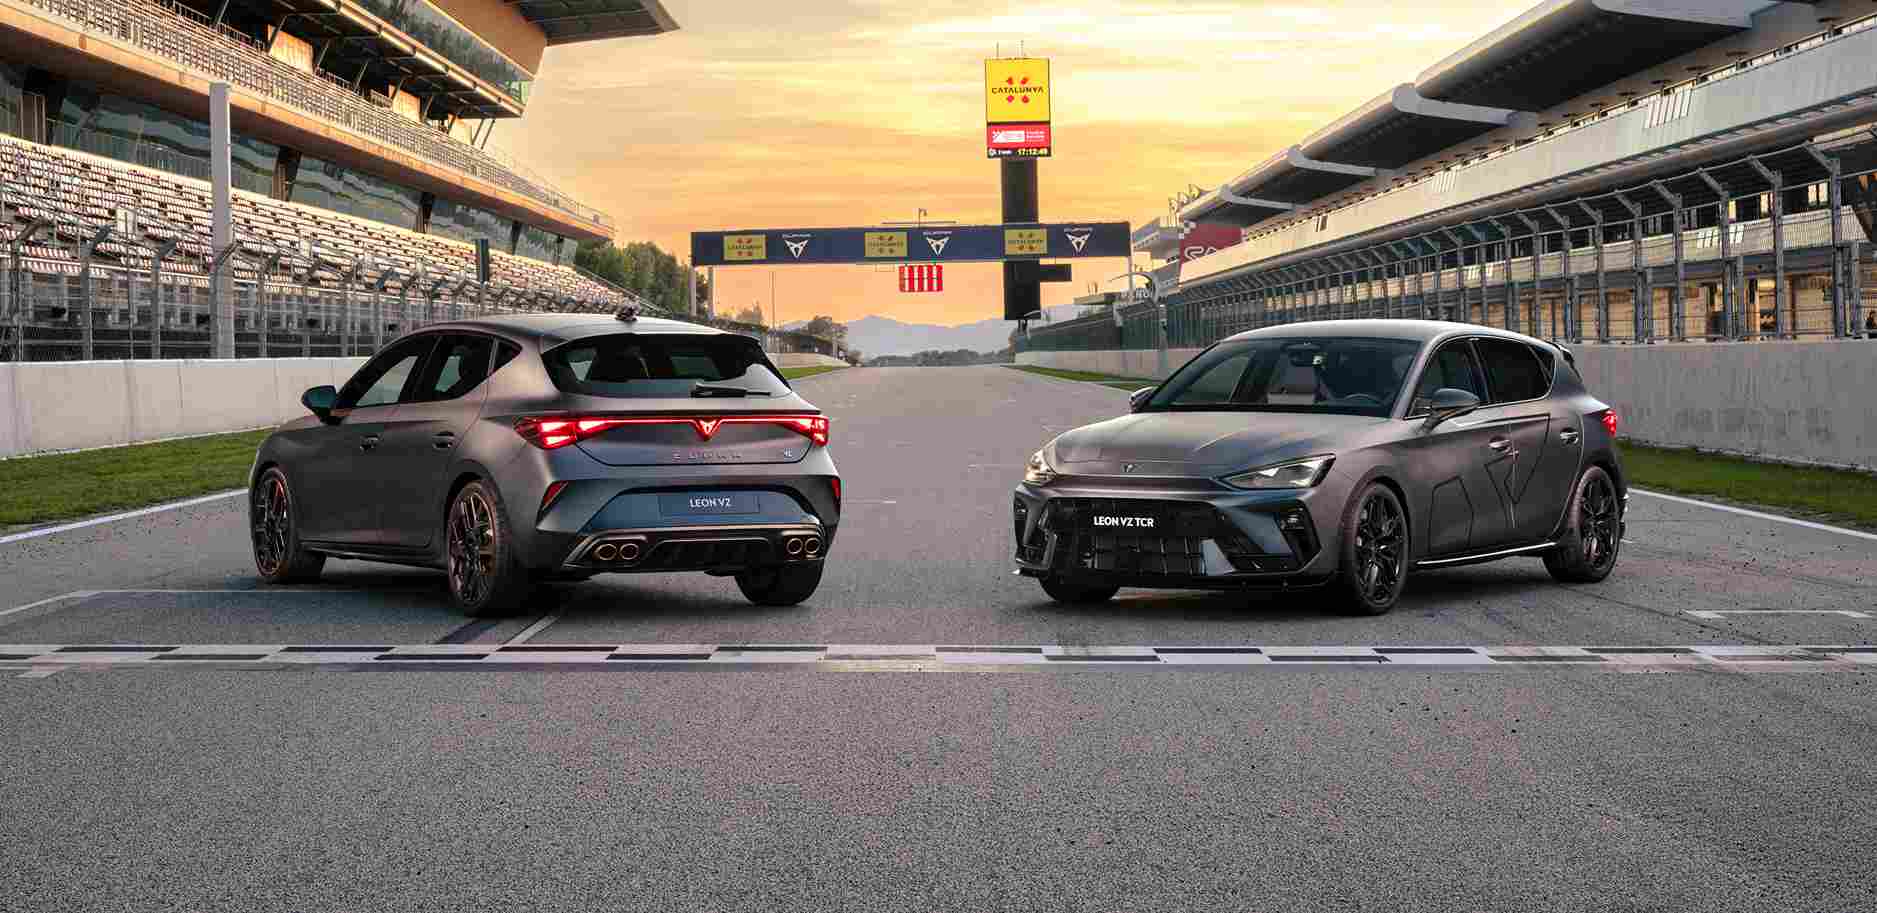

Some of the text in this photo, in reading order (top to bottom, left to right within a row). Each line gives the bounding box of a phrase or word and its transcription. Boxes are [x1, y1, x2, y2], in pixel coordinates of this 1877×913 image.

[689, 498, 717, 508] LEON
[1093, 516, 1155, 528] LEON VZ TCR
